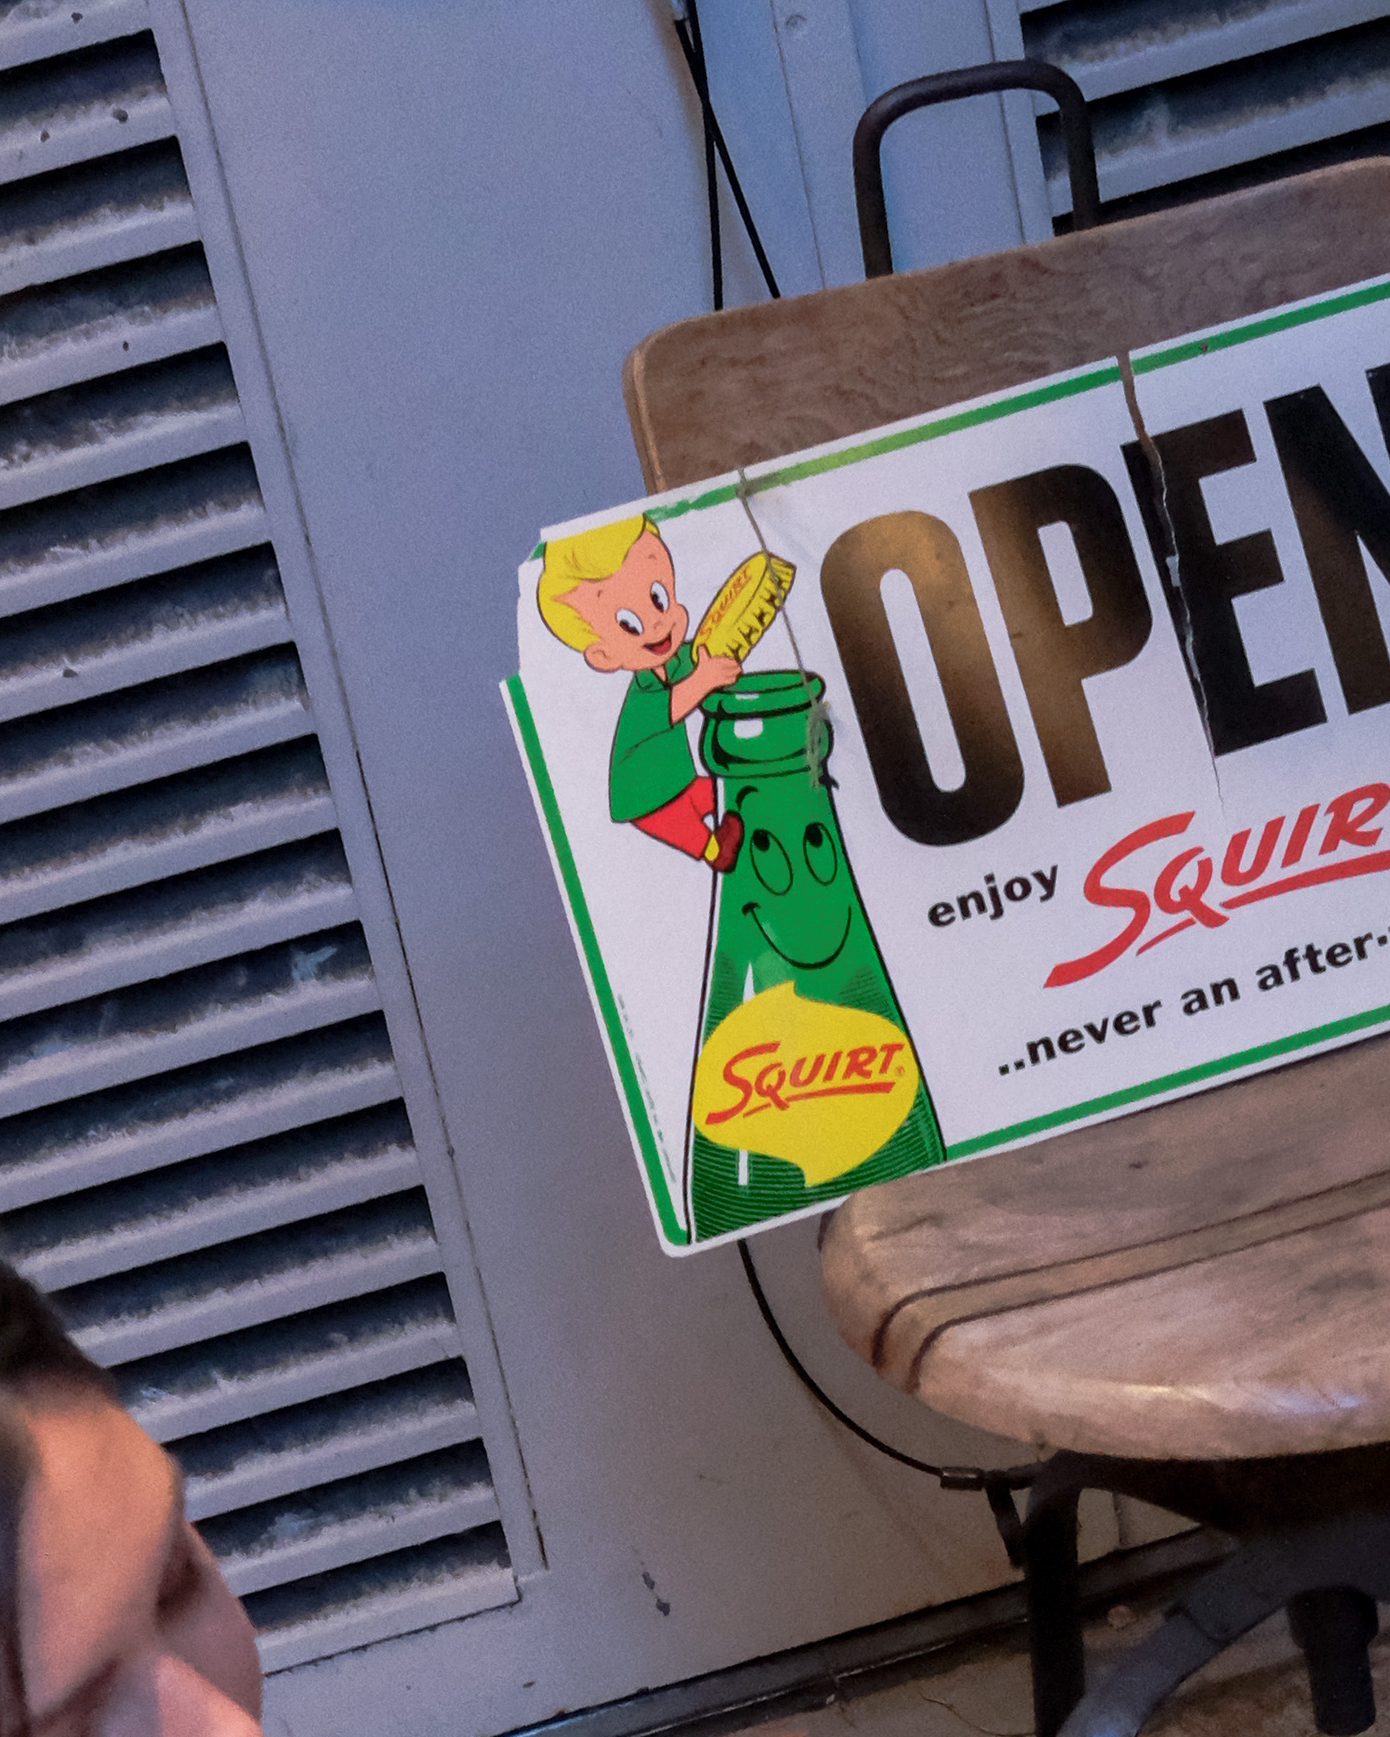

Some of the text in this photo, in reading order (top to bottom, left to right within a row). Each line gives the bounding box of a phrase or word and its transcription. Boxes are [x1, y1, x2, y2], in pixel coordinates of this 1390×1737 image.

[926, 864, 1059, 928] enjoy
[1180, 976, 1242, 1017] an
[704, 1041, 906, 1127] SQUIRT
